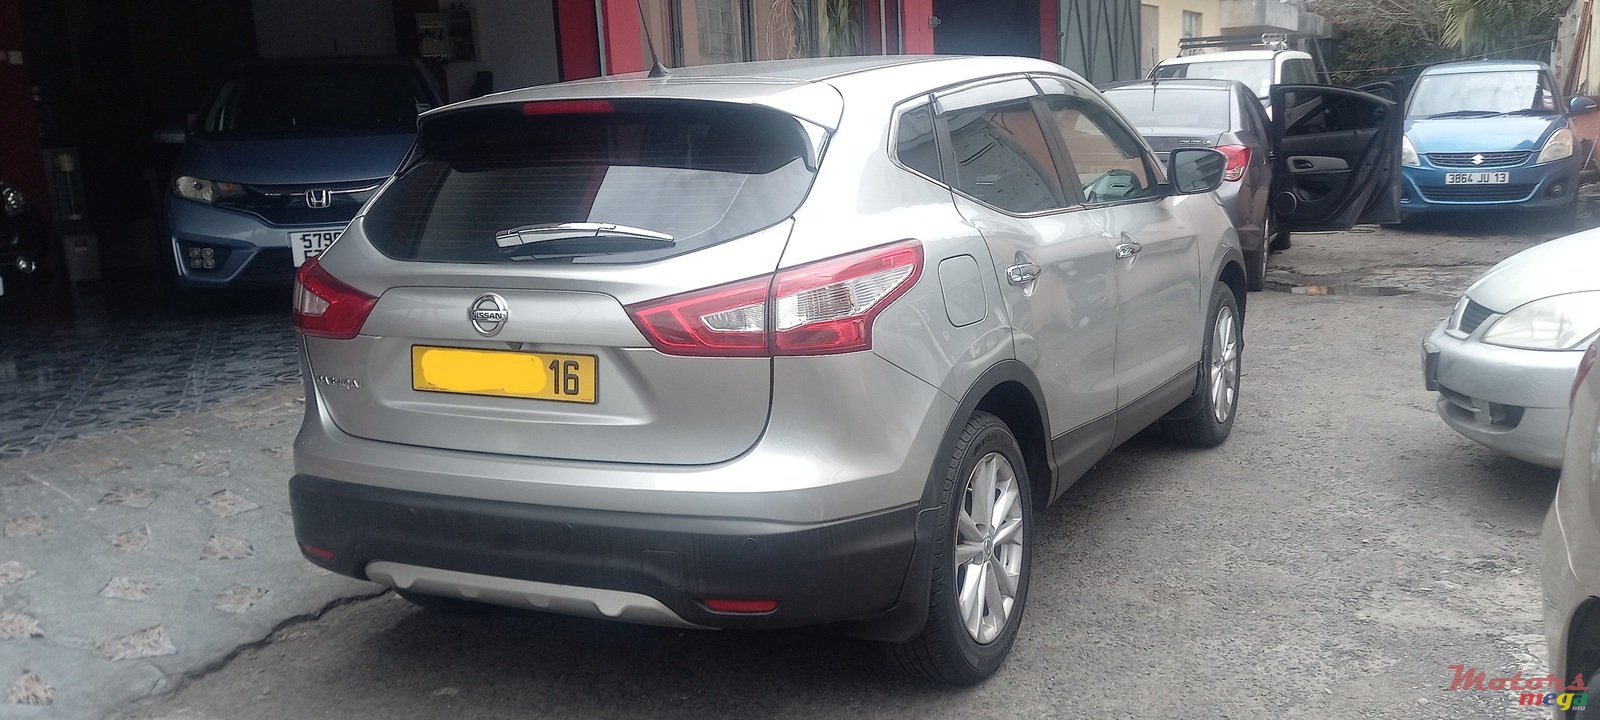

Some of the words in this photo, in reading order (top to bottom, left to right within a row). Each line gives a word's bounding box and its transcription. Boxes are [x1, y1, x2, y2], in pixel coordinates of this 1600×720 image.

[1449, 173, 1473, 184] 3864
[1477, 173, 1490, 183] JU
[1494, 173, 1506, 183] 13
[548, 359, 580, 396] 16
